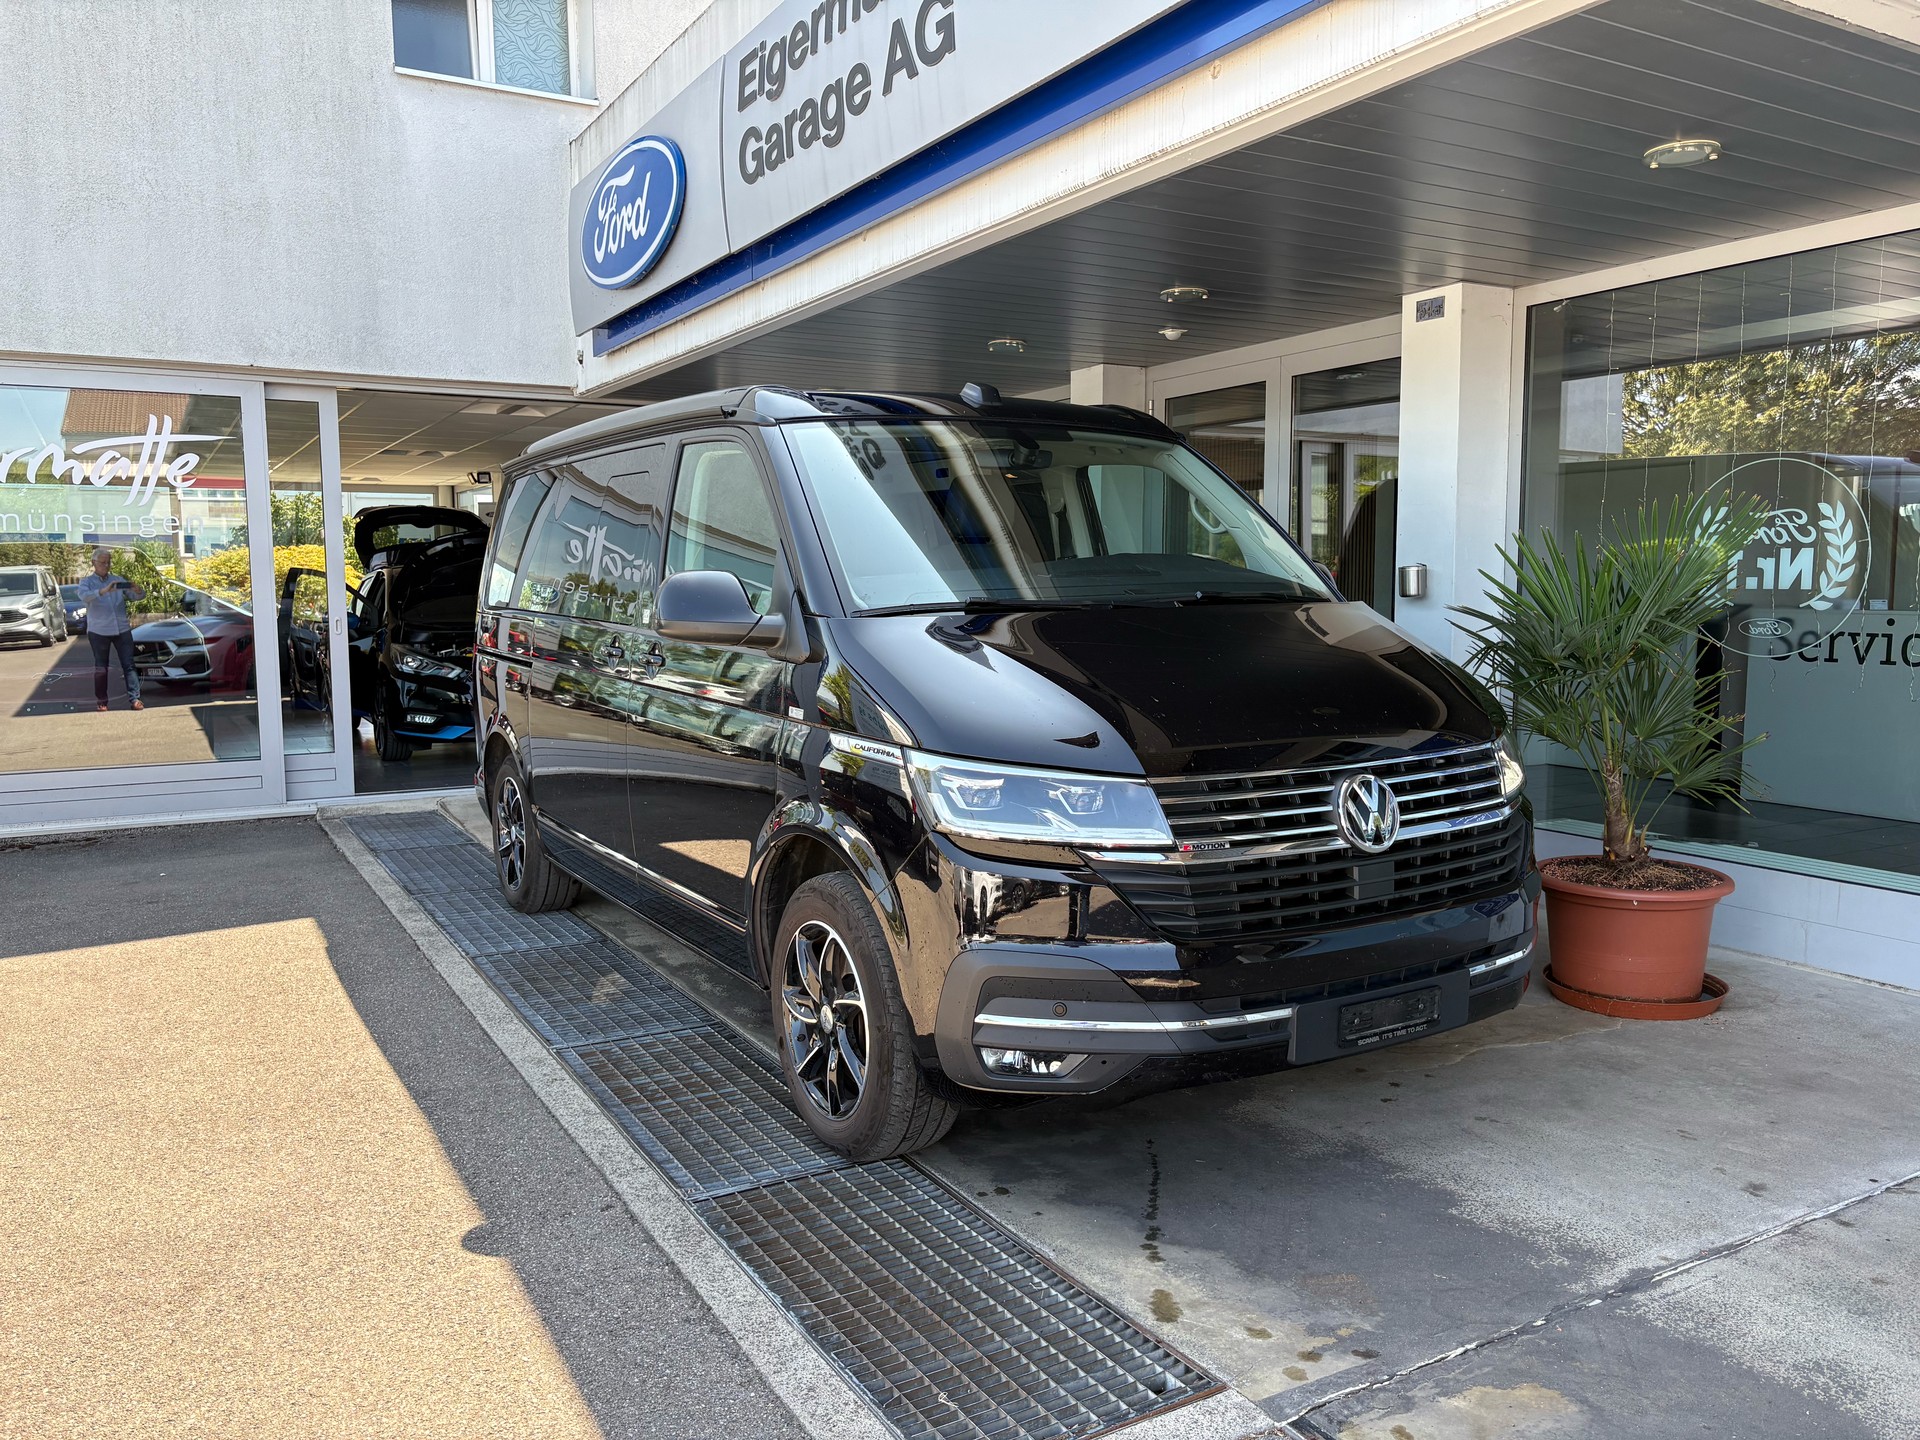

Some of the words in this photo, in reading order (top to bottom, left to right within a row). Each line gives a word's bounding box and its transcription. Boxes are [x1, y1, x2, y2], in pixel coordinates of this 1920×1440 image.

[738, 0, 884, 113] Eigerm
[739, 62, 873, 186] Garage
[881, 0, 957, 97] AG
[594, 164, 652, 264] Ford
[0, 508, 204, 539] münsingen
[854, 743, 896, 758] CALIFORNIA
[1394, 1029, 1407, 1037] TIME
